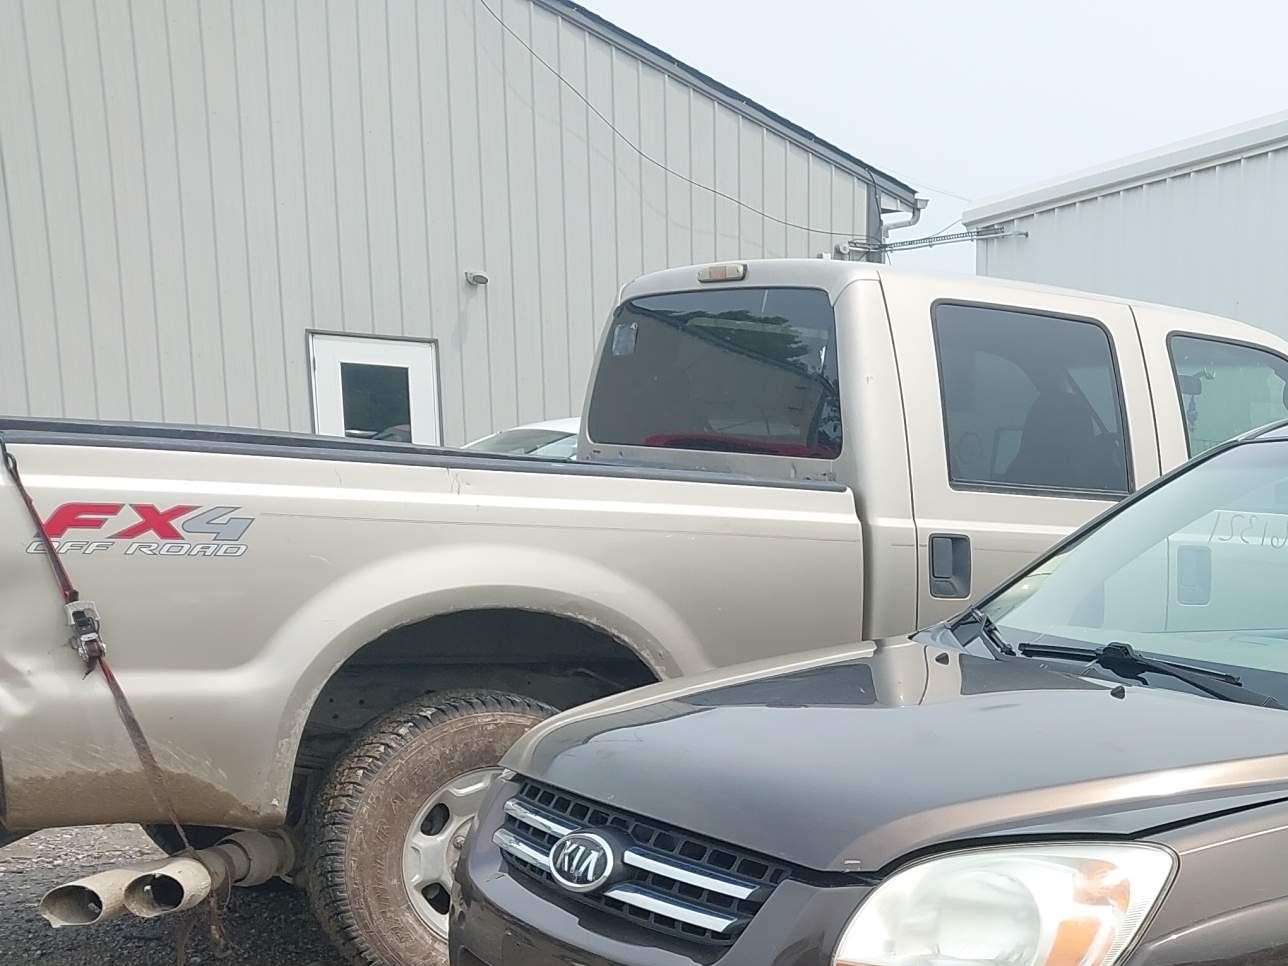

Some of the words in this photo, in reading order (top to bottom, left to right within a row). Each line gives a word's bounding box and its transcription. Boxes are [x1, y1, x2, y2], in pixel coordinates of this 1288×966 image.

[34, 501, 256, 542] FX4
[25, 540, 115, 556] OFF
[124, 541, 249, 557] ROAD
[556, 840, 600, 881] KIA
